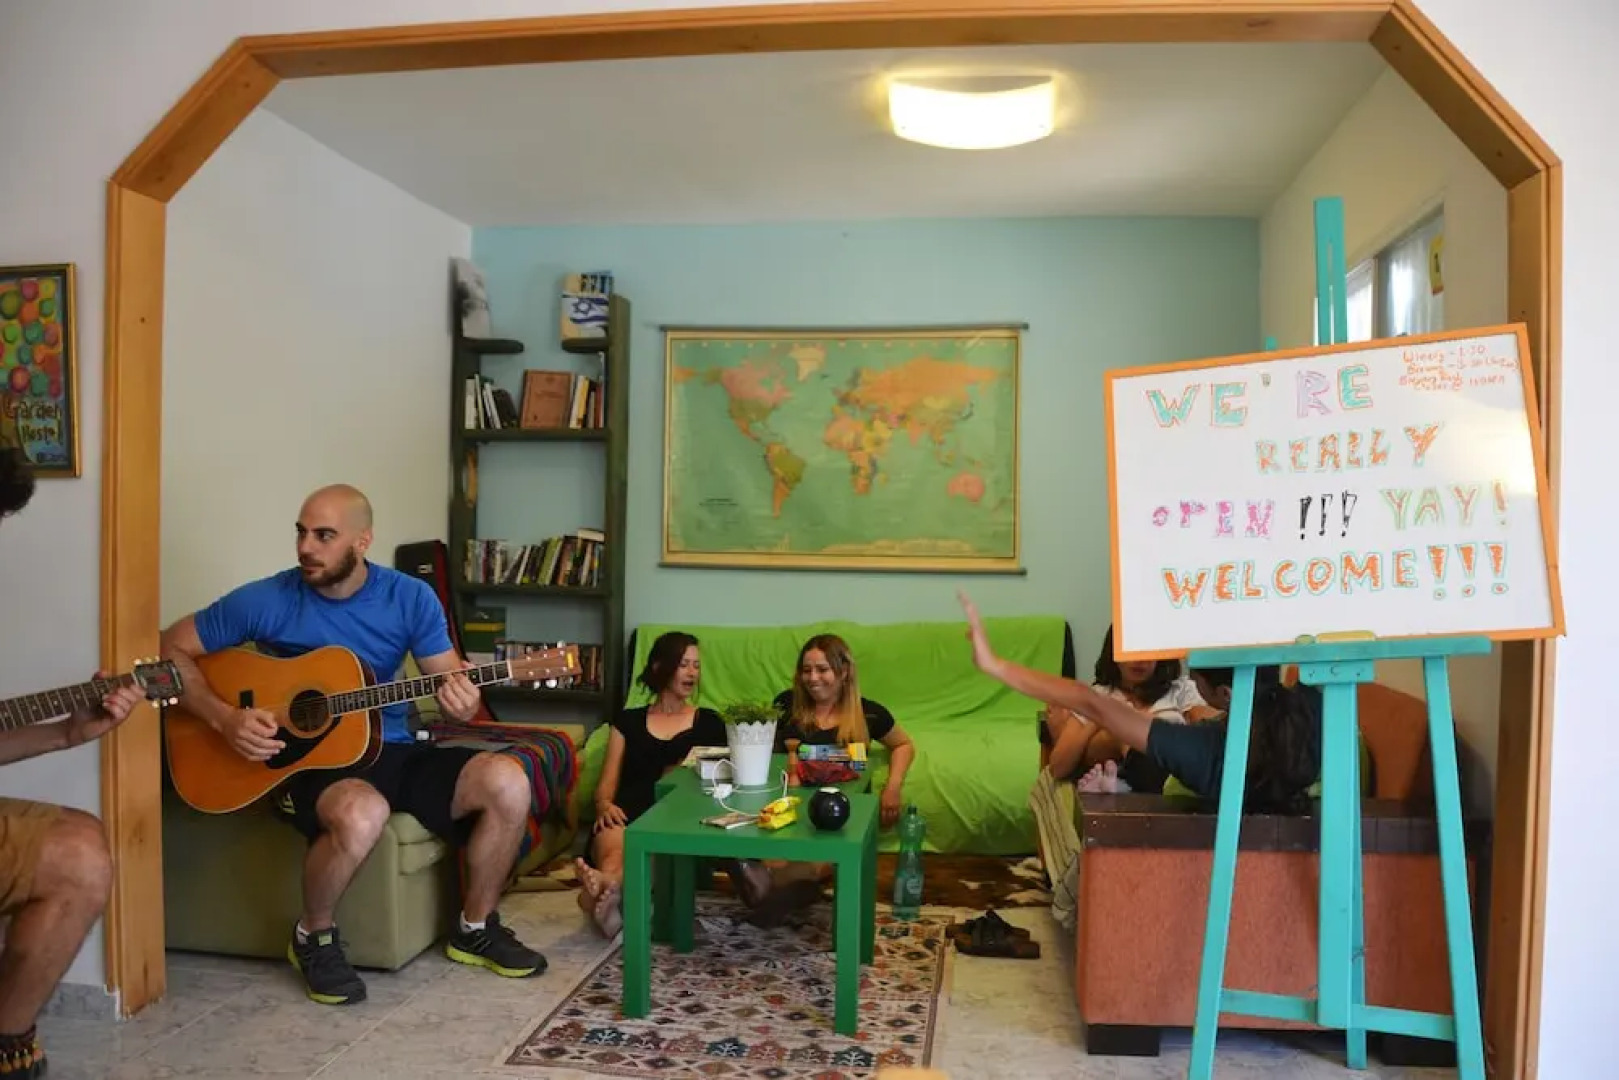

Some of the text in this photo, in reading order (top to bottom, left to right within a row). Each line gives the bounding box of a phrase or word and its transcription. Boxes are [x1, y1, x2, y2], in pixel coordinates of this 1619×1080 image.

[1145, 363, 1374, 429] WE'RE
[1256, 421, 1444, 473] REALLY
[1380, 481, 1511, 530] YAY!
[1162, 541, 1509, 609] WELCOME!!!
